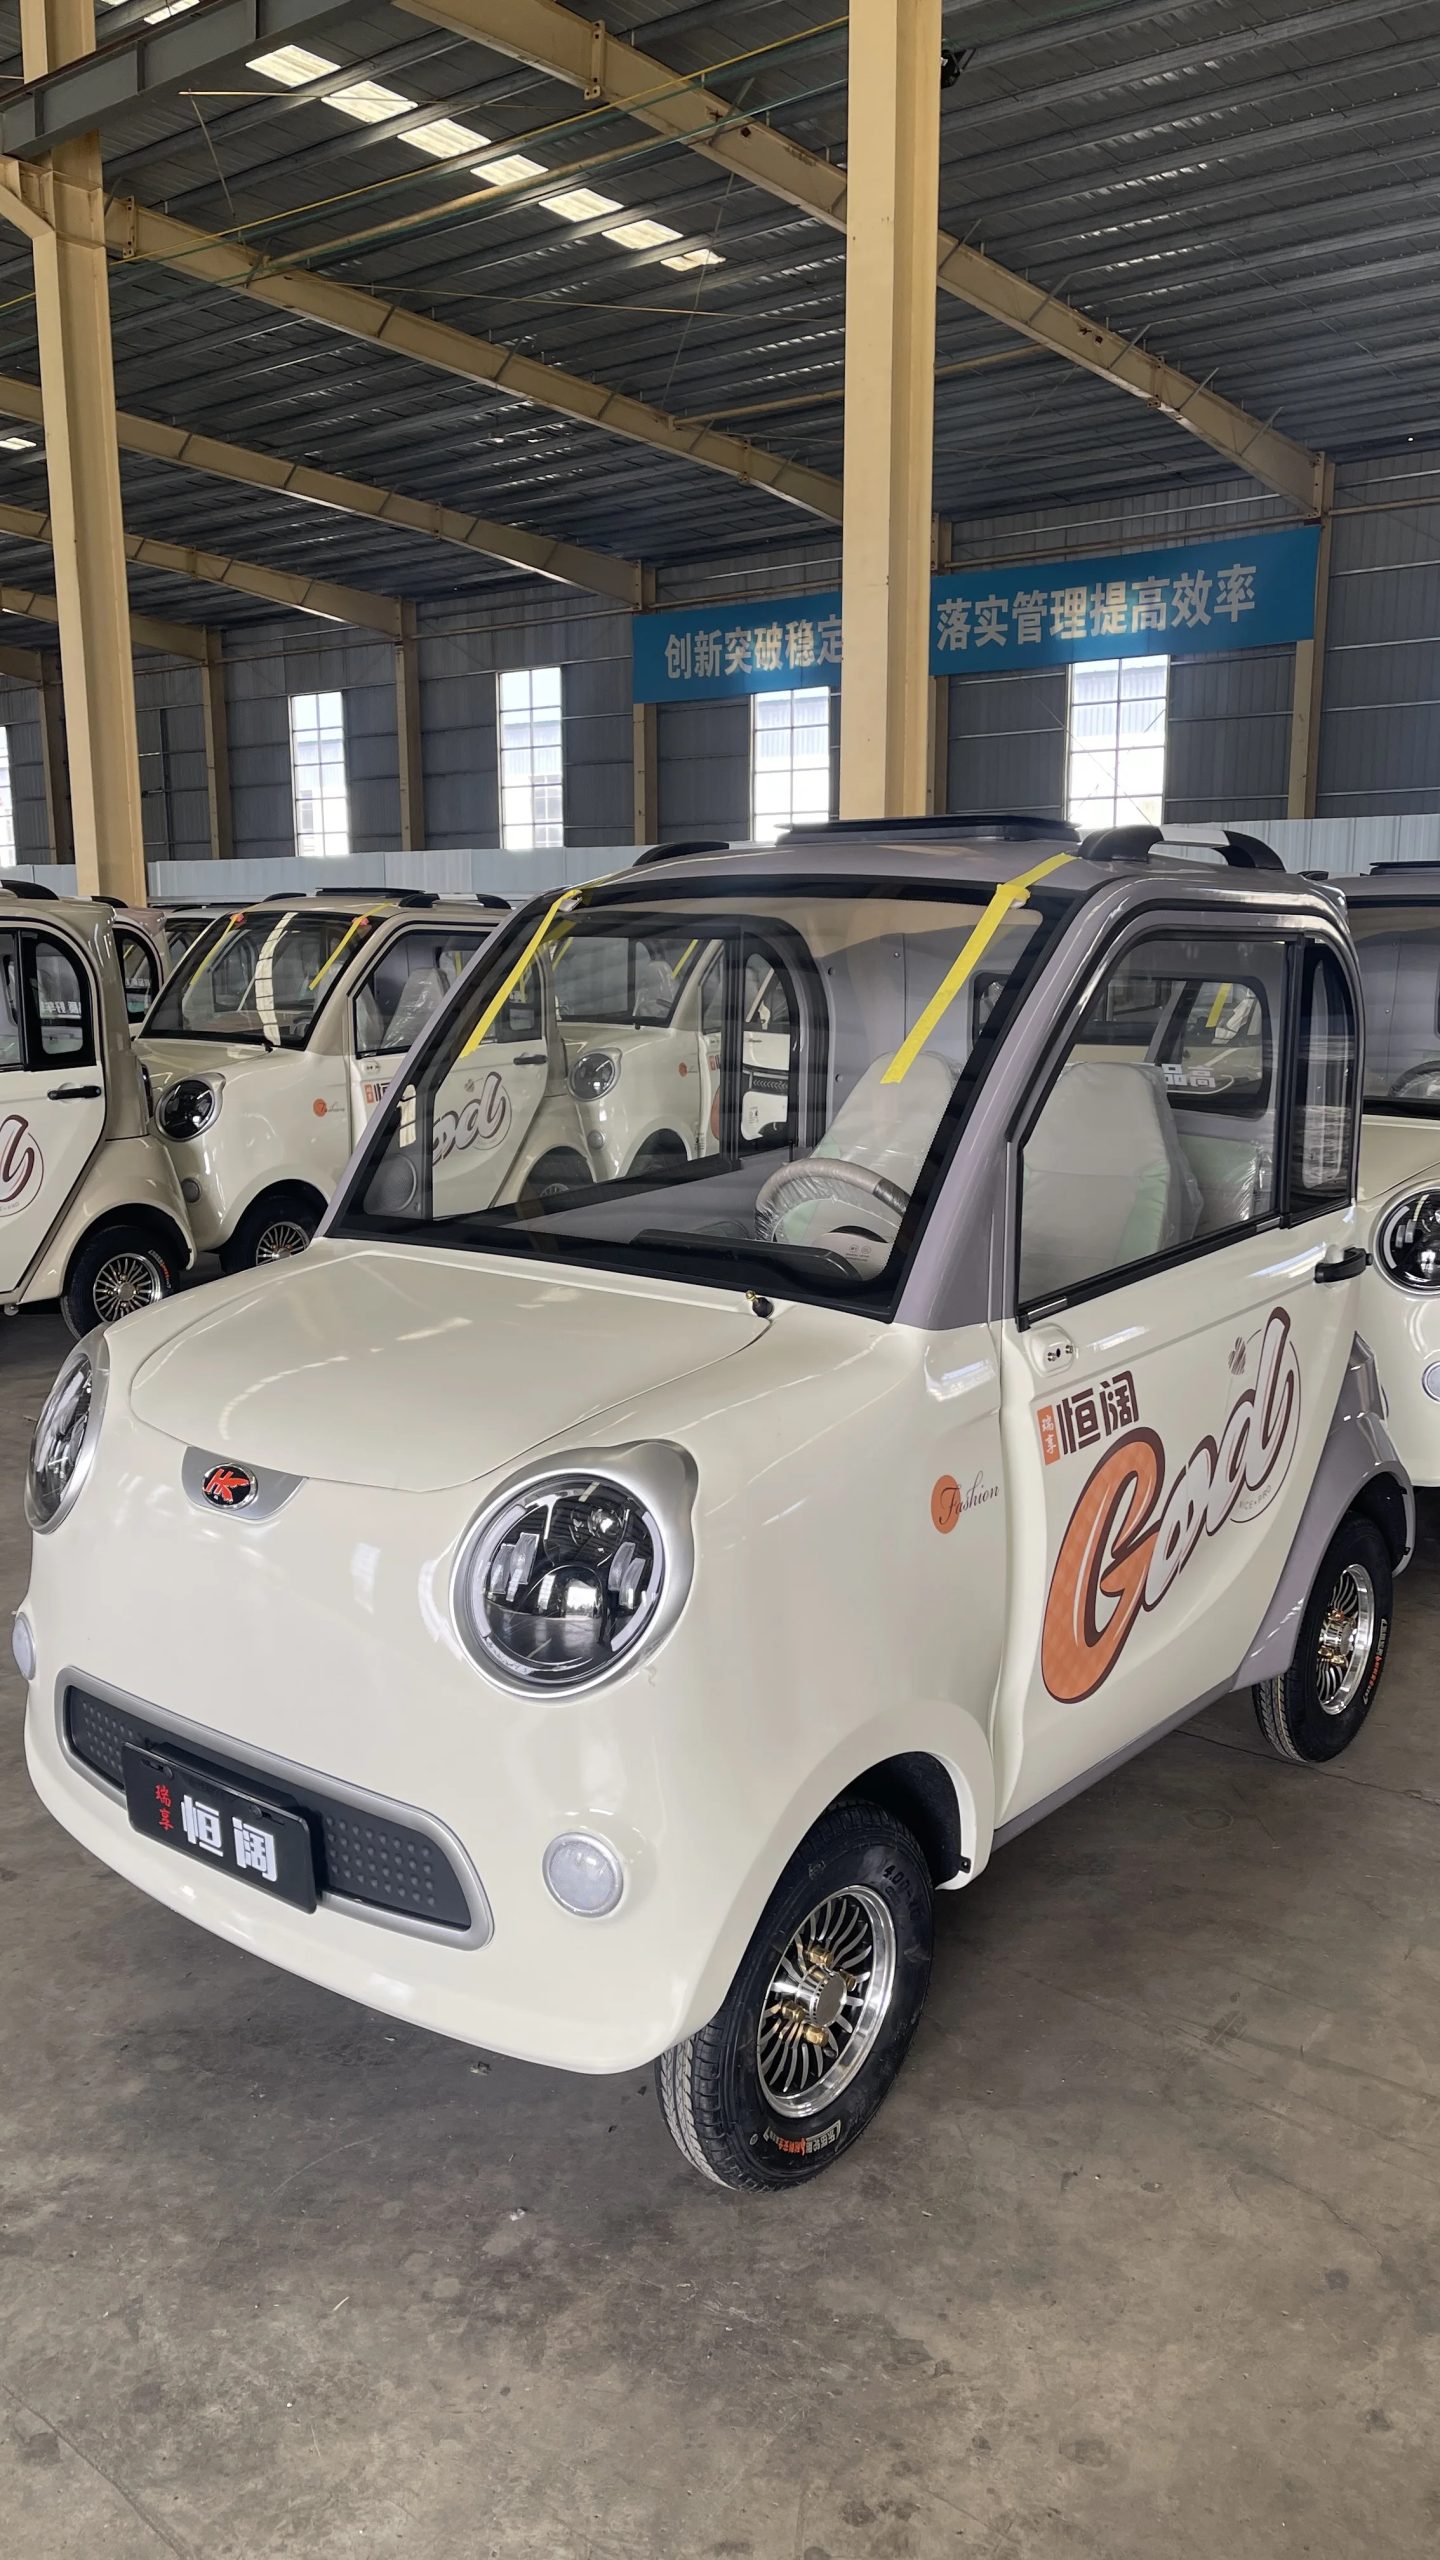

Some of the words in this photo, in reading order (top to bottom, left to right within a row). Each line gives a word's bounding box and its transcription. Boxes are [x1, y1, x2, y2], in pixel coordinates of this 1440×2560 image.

[664, 613, 842, 680] 创新突破稳定
[936, 563, 1257, 651] 落实管理提高效率
[1056, 1370, 1140, 1456] 恒阔
[938, 1470, 999, 1526] Fashion
[181, 1794, 278, 1882] 恒阔
